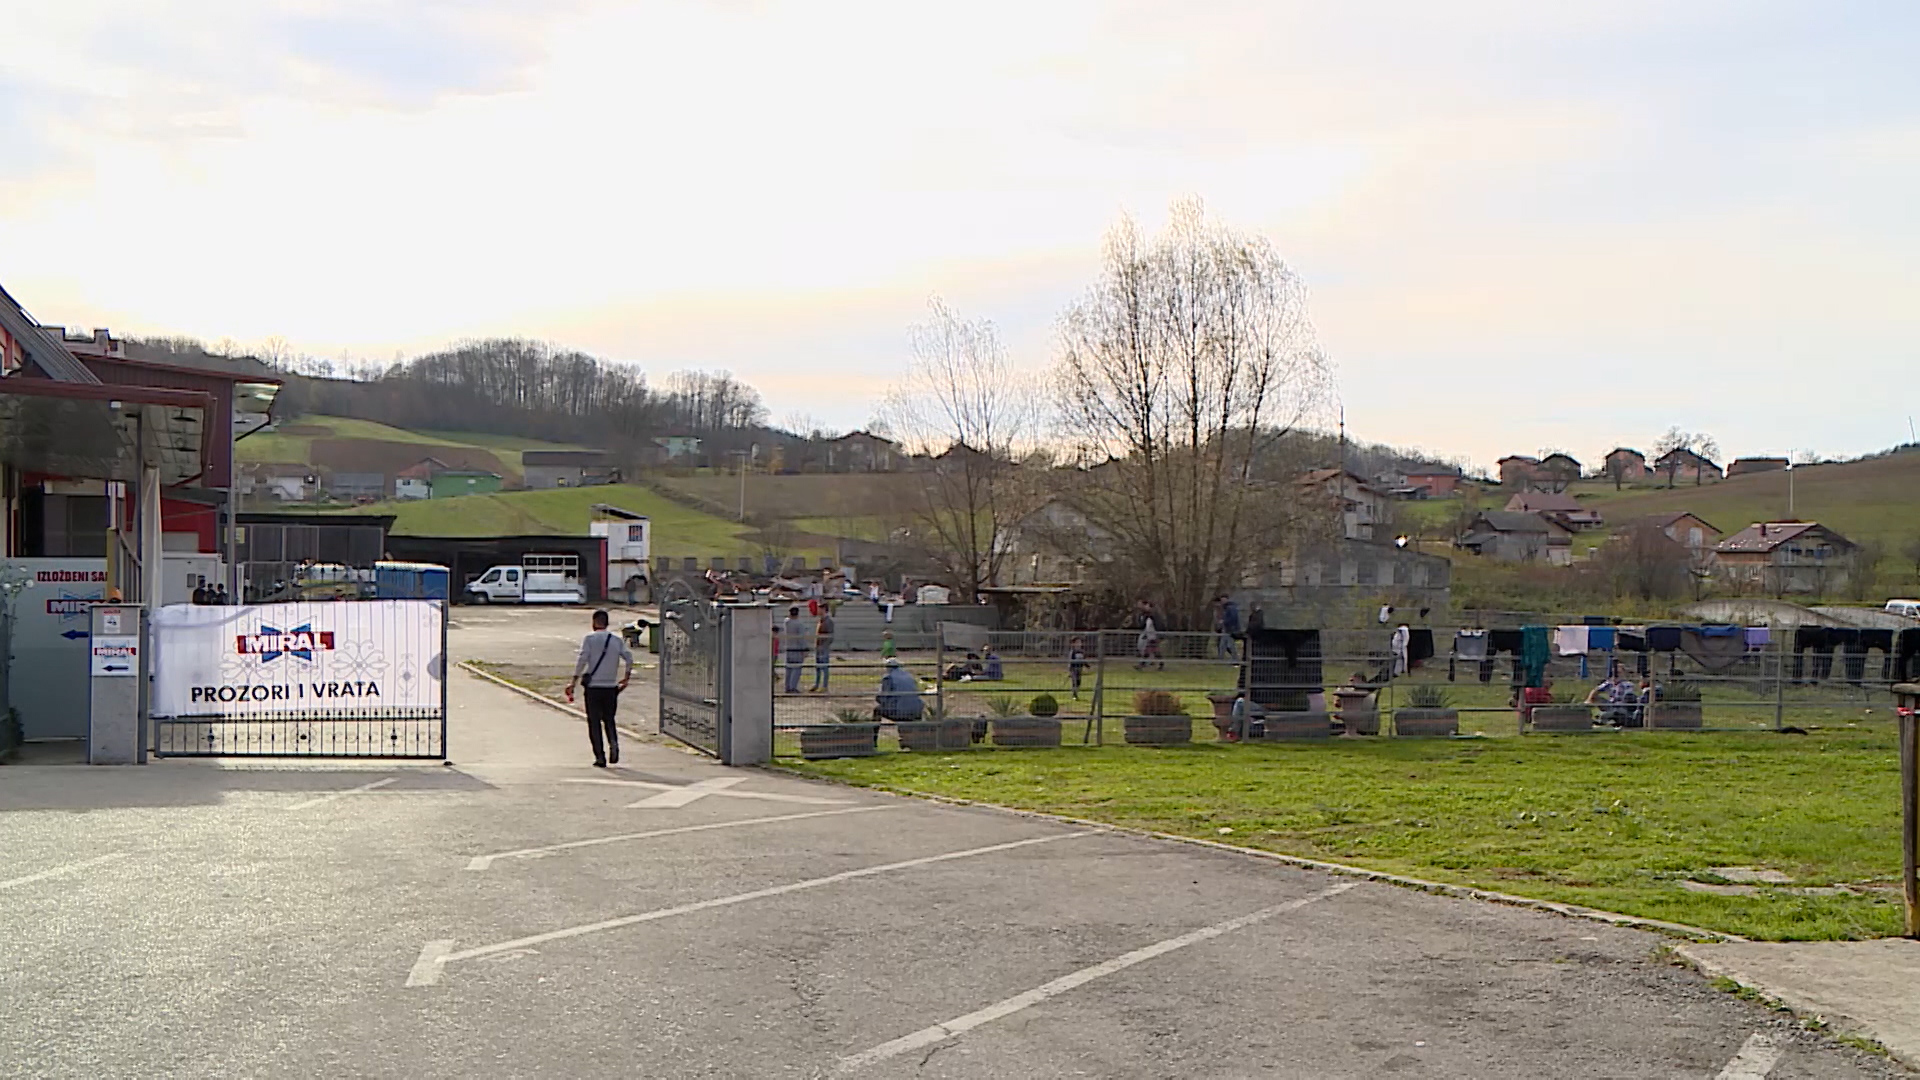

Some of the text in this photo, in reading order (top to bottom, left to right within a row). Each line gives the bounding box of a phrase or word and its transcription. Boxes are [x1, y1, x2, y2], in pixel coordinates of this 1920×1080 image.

[245, 633, 327, 653] MIRAL
[191, 683, 290, 703] PROZORI
[312, 681, 380, 698] VRATA
